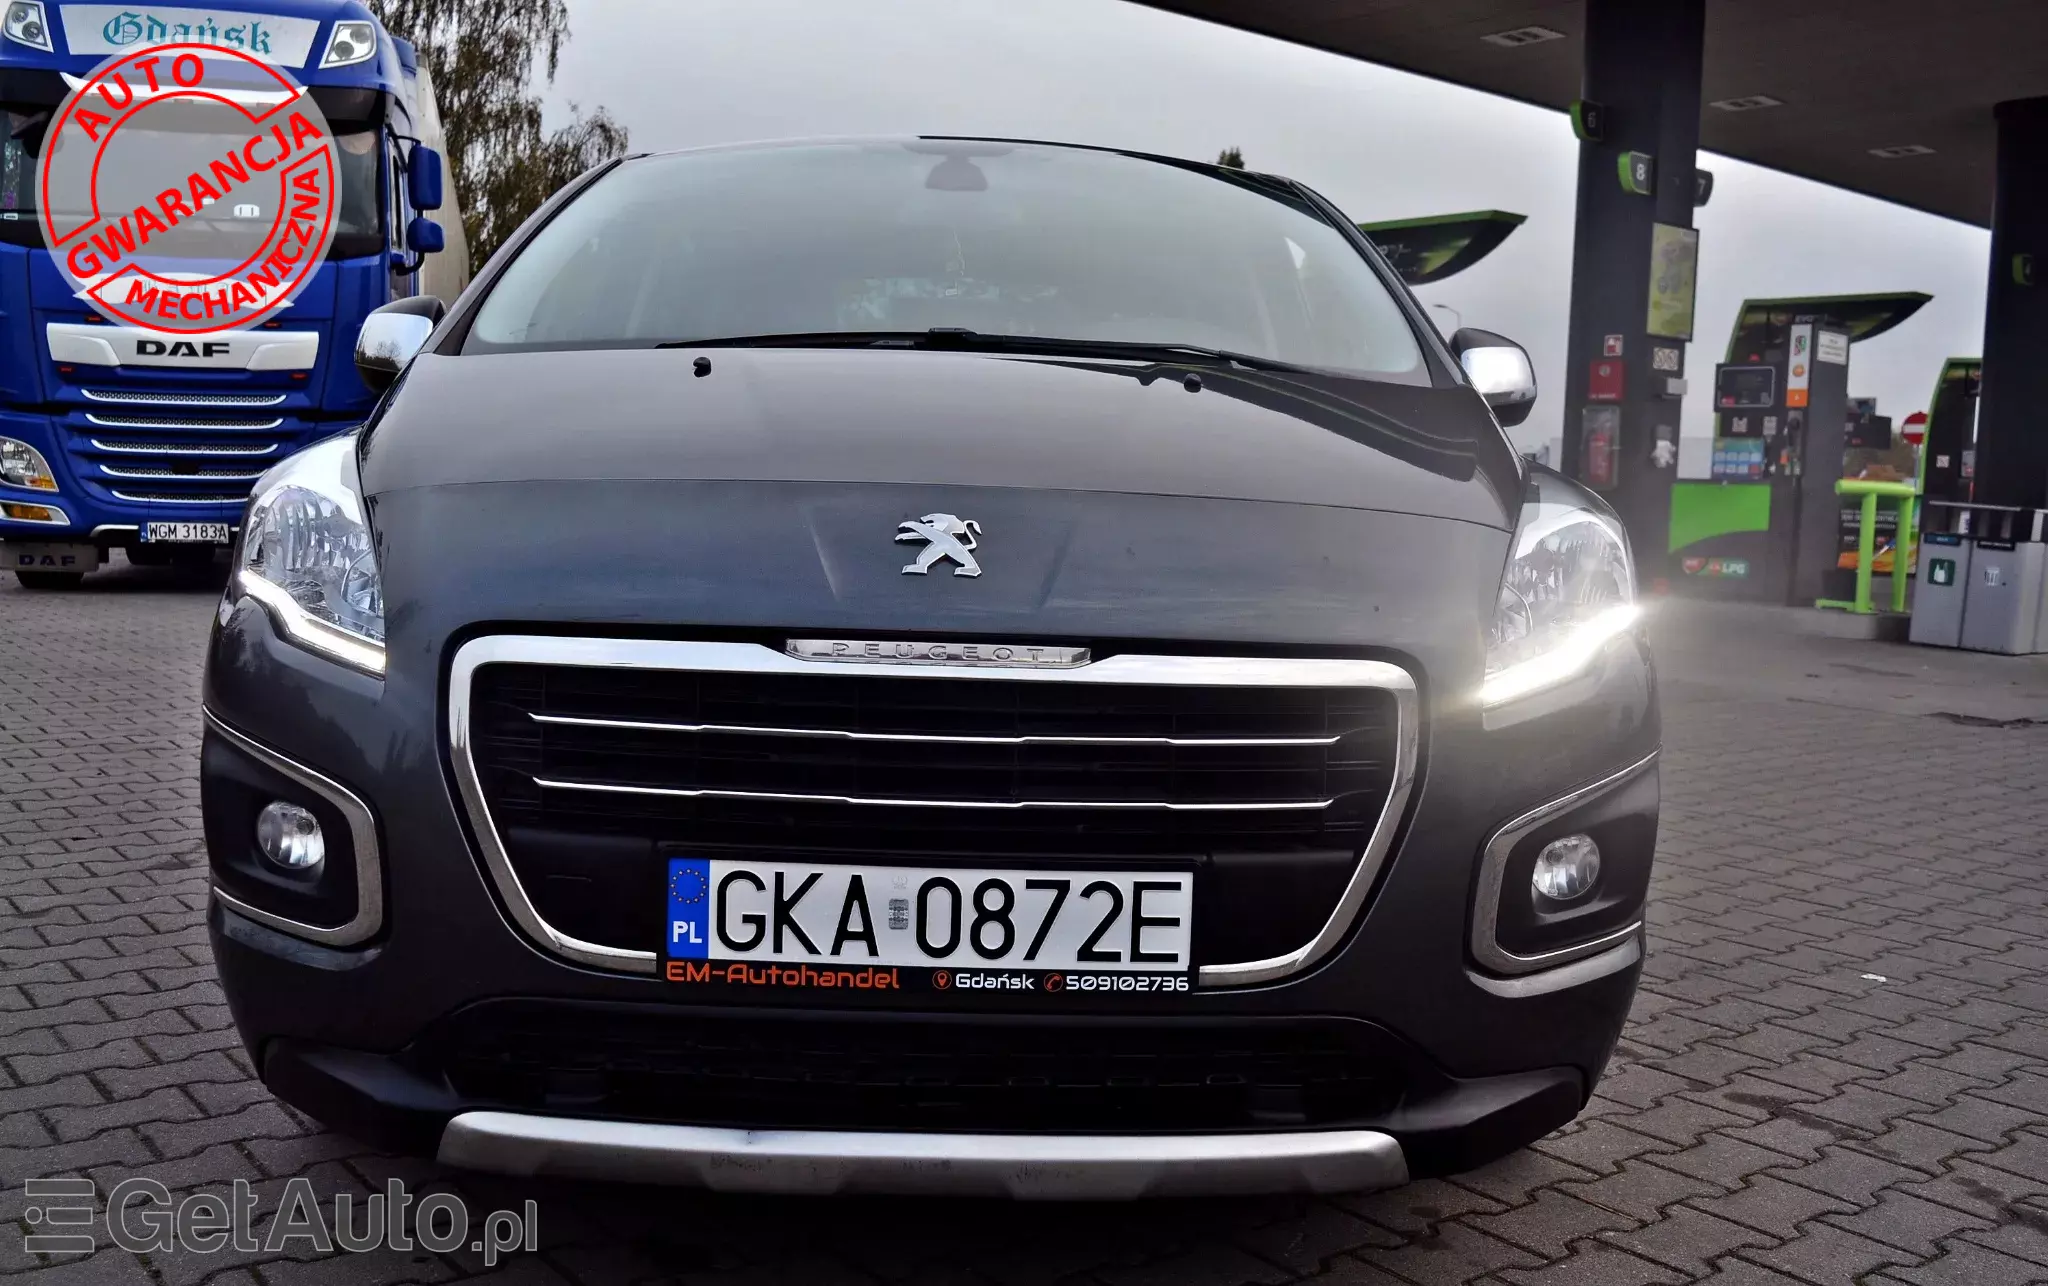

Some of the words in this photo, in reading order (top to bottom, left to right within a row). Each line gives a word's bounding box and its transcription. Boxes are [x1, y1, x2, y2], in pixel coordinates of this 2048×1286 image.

[102, 11, 272, 55] Gdańsk
[1636, 163, 1646, 180] 8
[136, 339, 230, 358] DAF
[149, 524, 177, 539] WGM
[182, 524, 227, 539] 3183A
[19, 554, 76, 567] DAF
[1722, 562, 1746, 574] LPG
[832, 642, 1044, 662] PEUGEOT
[716, 869, 879, 957] GKA
[915, 877, 1183, 963] 0872E
[672, 921, 702, 944] PL
[666, 961, 900, 989] EM-Autohandel
[955, 972, 1035, 991] Gdańsk
[1065, 975, 1189, 992] 509102736
